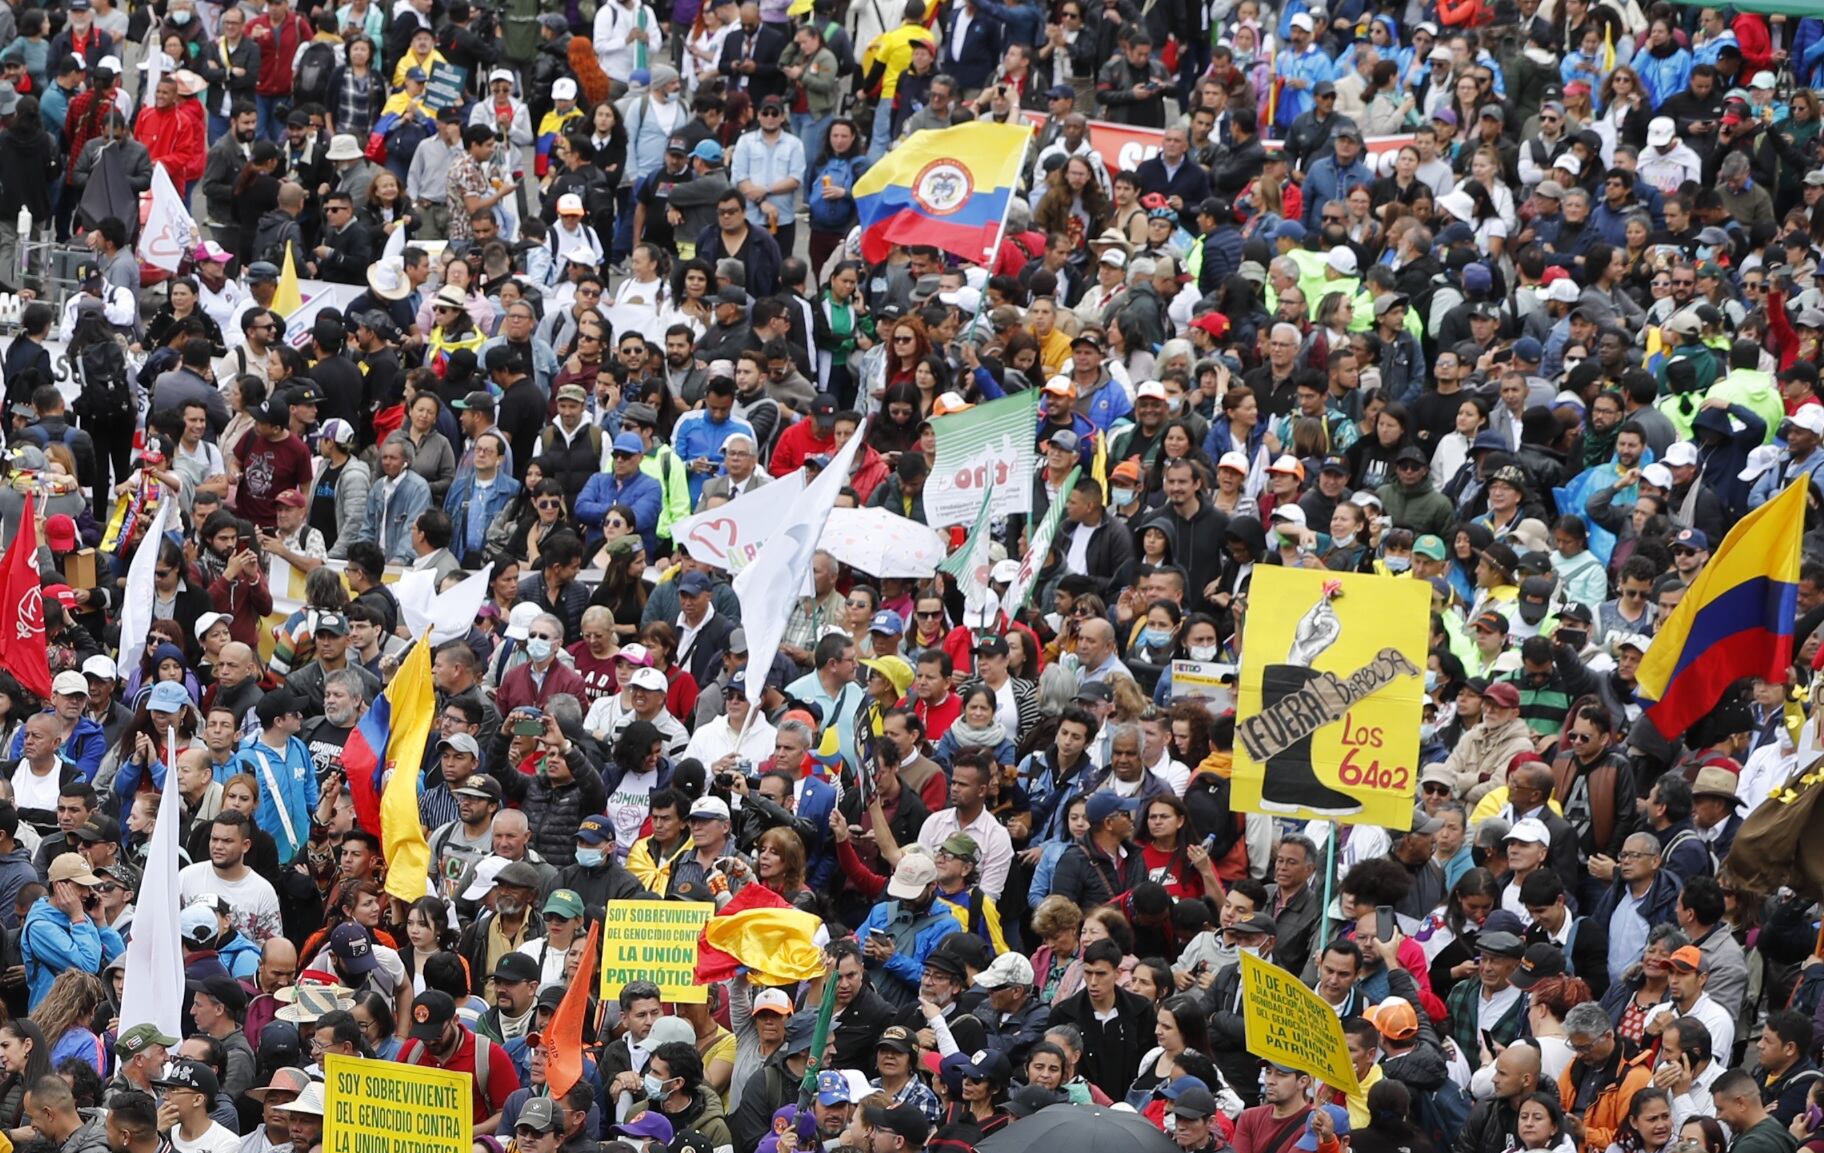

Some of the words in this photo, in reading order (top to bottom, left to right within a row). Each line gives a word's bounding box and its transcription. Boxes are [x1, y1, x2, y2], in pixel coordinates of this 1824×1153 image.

[1338, 748, 1408, 790] 6402
[610, 791, 649, 807] COMUNE
[609, 909, 627, 922] SOY
[607, 928, 622, 940] DEL
[624, 928, 672, 942] GENOCIDIO
[618, 945, 638, 962] LA
[643, 944, 693, 964] UNIÓN
[606, 967, 696, 987] PATRIÓTIC
[1266, 972, 1281, 993] DE
[1270, 1023, 1287, 1038] LA
[338, 1071, 360, 1096] SOY
[365, 1075, 459, 1110] SOBREVIVIENTE
[336, 1100, 355, 1126] DEL
[359, 1104, 413, 1133] GENOCIDIO
[416, 1113, 461, 1140] CONTRA
[335, 1129, 350, 1153] LA
